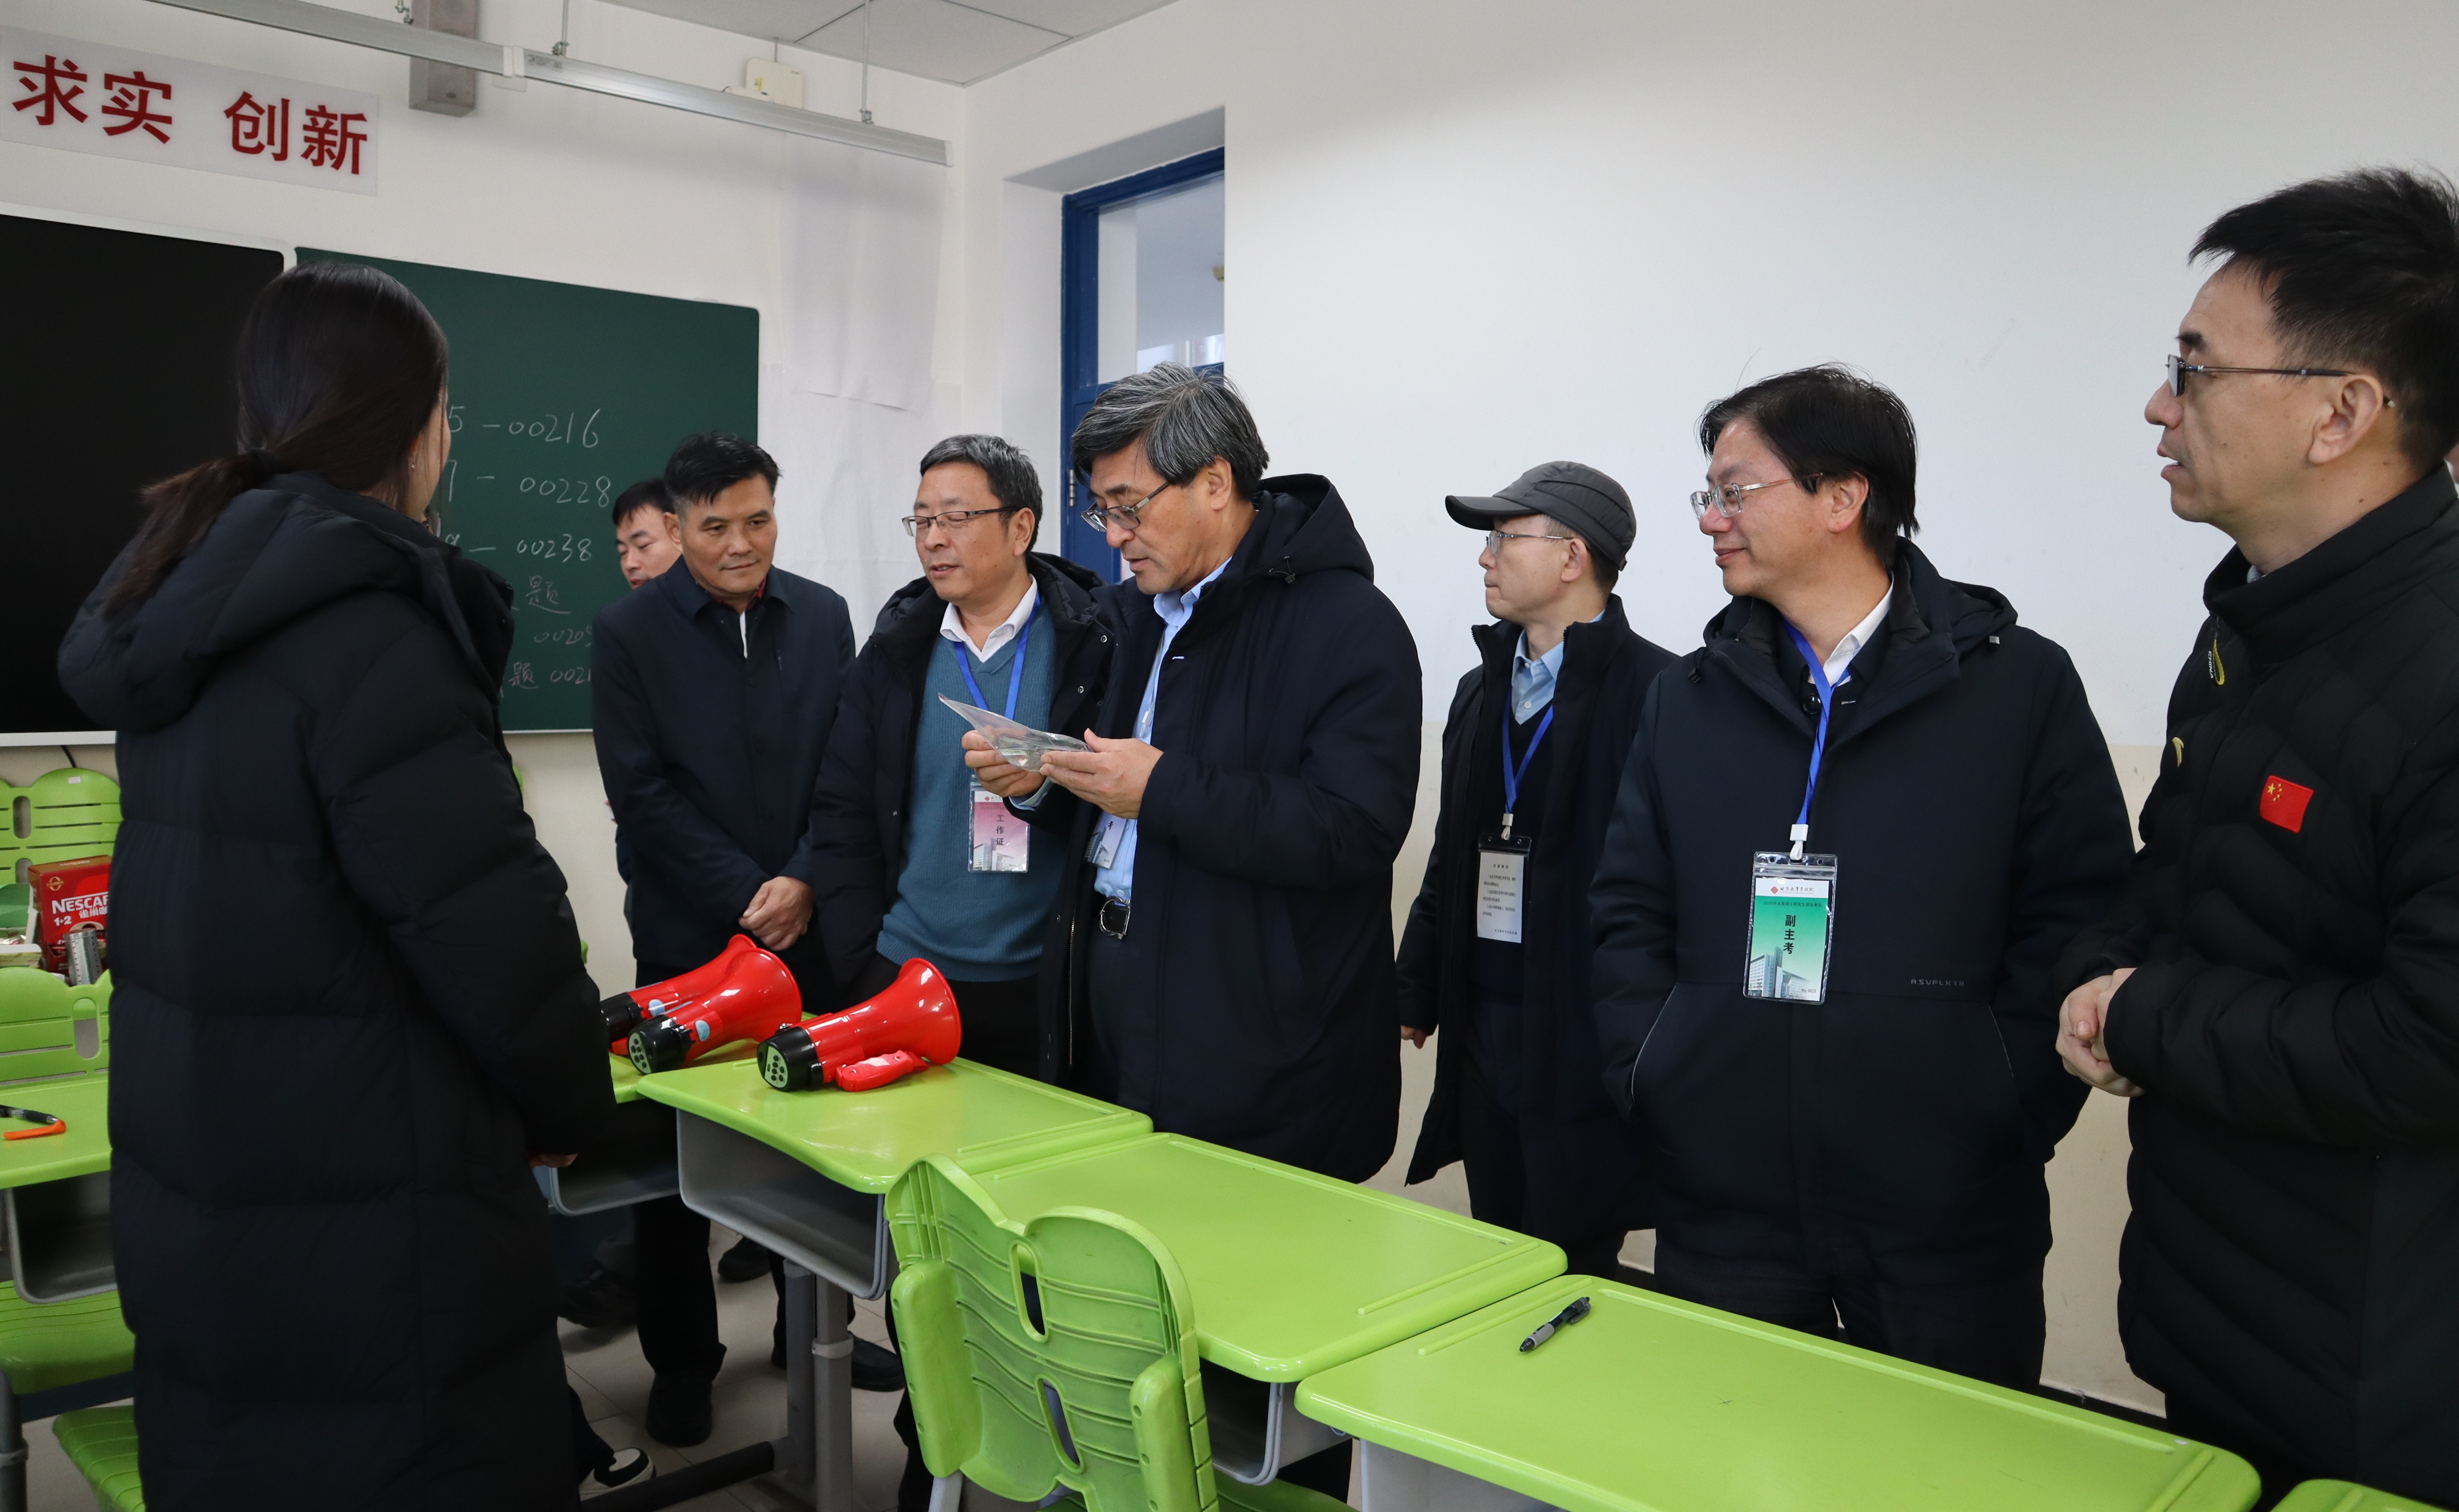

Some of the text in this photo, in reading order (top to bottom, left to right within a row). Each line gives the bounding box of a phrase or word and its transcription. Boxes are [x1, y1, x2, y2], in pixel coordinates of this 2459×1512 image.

[12, 55, 367, 175] 求实 创新
[509, 408, 600, 448] 00216
[520, 476, 611, 508] 00228
[517, 534, 592, 563] 00238
[511, 575, 572, 614] 题
[995, 814, 1005, 846] 工作证
[1108, 821, 1114, 830] 考
[54, 915, 72, 926] 1+2
[1783, 915, 1797, 954] 副主考
